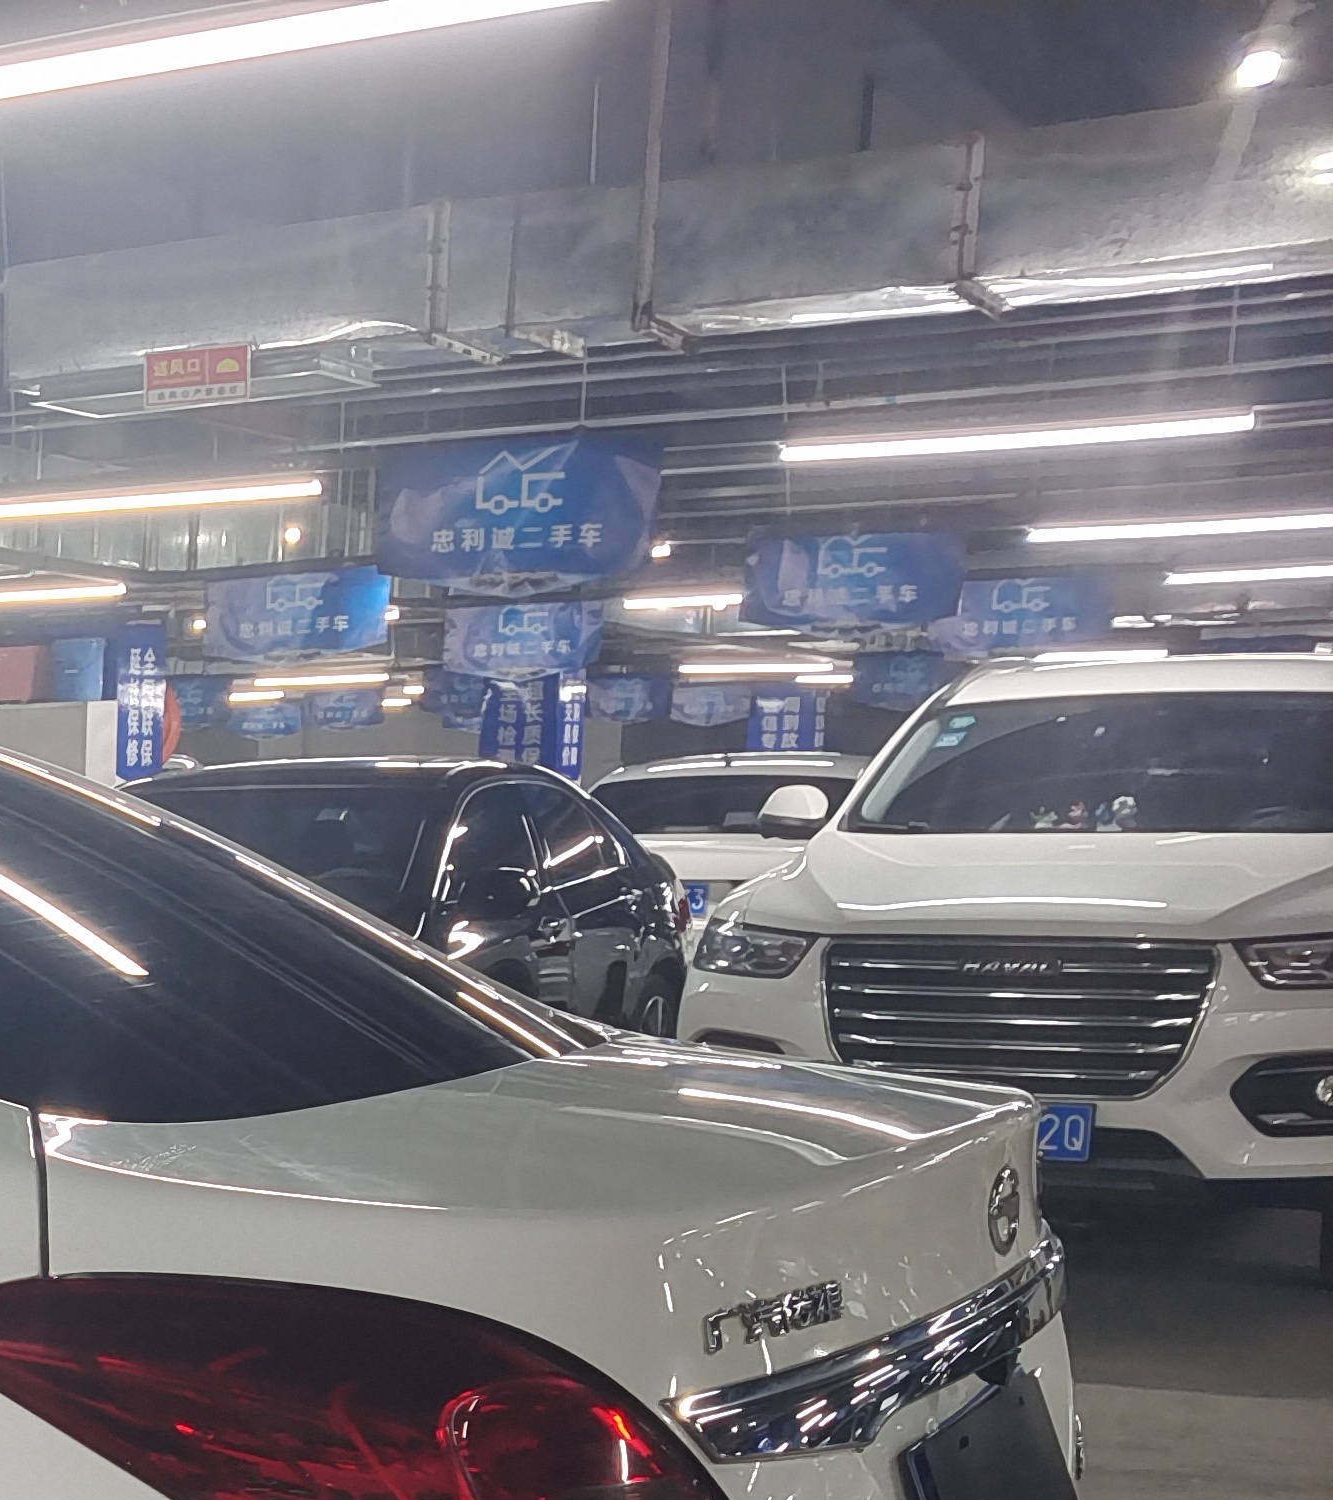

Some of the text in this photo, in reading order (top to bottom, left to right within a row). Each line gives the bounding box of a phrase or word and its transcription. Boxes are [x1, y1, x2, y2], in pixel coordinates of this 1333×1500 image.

[432, 523, 603, 553] 忠利诚二手车
